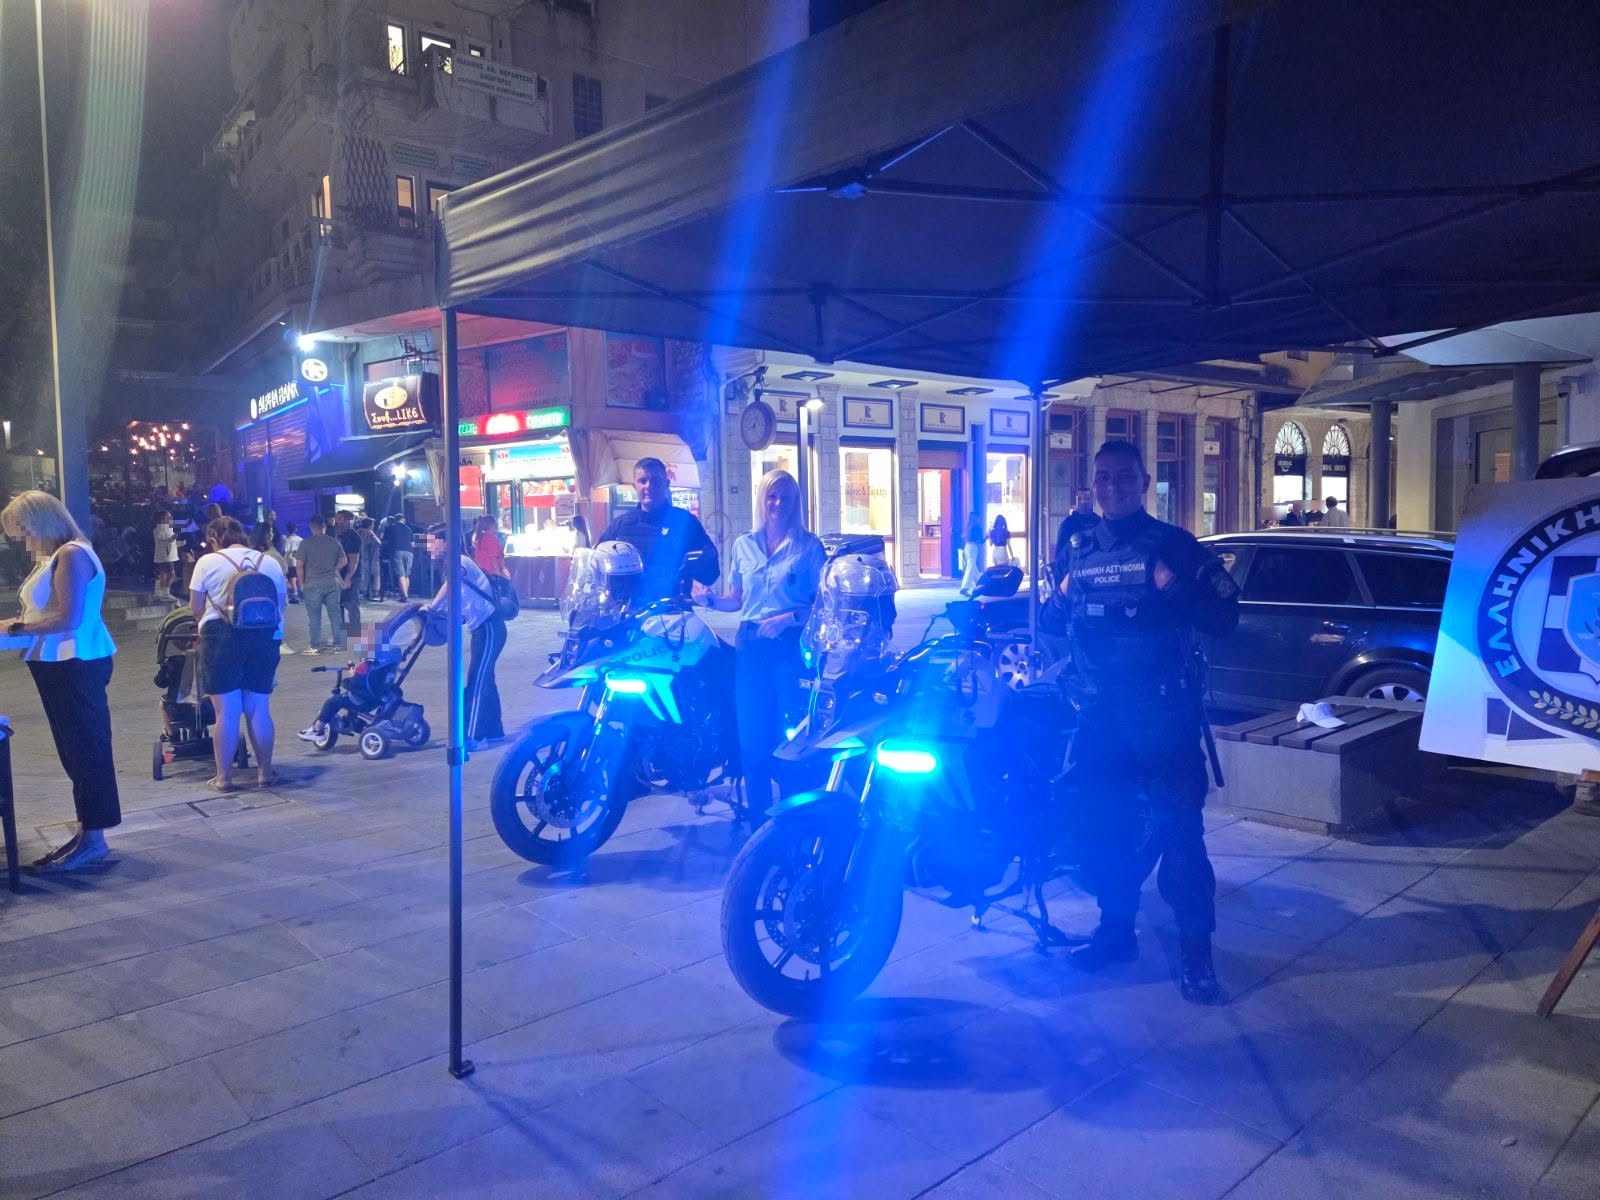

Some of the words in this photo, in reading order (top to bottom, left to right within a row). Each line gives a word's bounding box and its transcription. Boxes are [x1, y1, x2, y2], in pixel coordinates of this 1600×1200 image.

[258, 389, 279, 414] ALPHA
[279, 381, 299, 404] BANK
[1072, 567, 1104, 578] ΕΛΛΗΝΙΚΗ
[1105, 563, 1145, 573] ΑΣΤΥΝΟΜΙΑ
[1094, 574, 1121, 584] POLICE
[1488, 504, 1600, 678] ΕΛΛΗΝΙΚΗ
